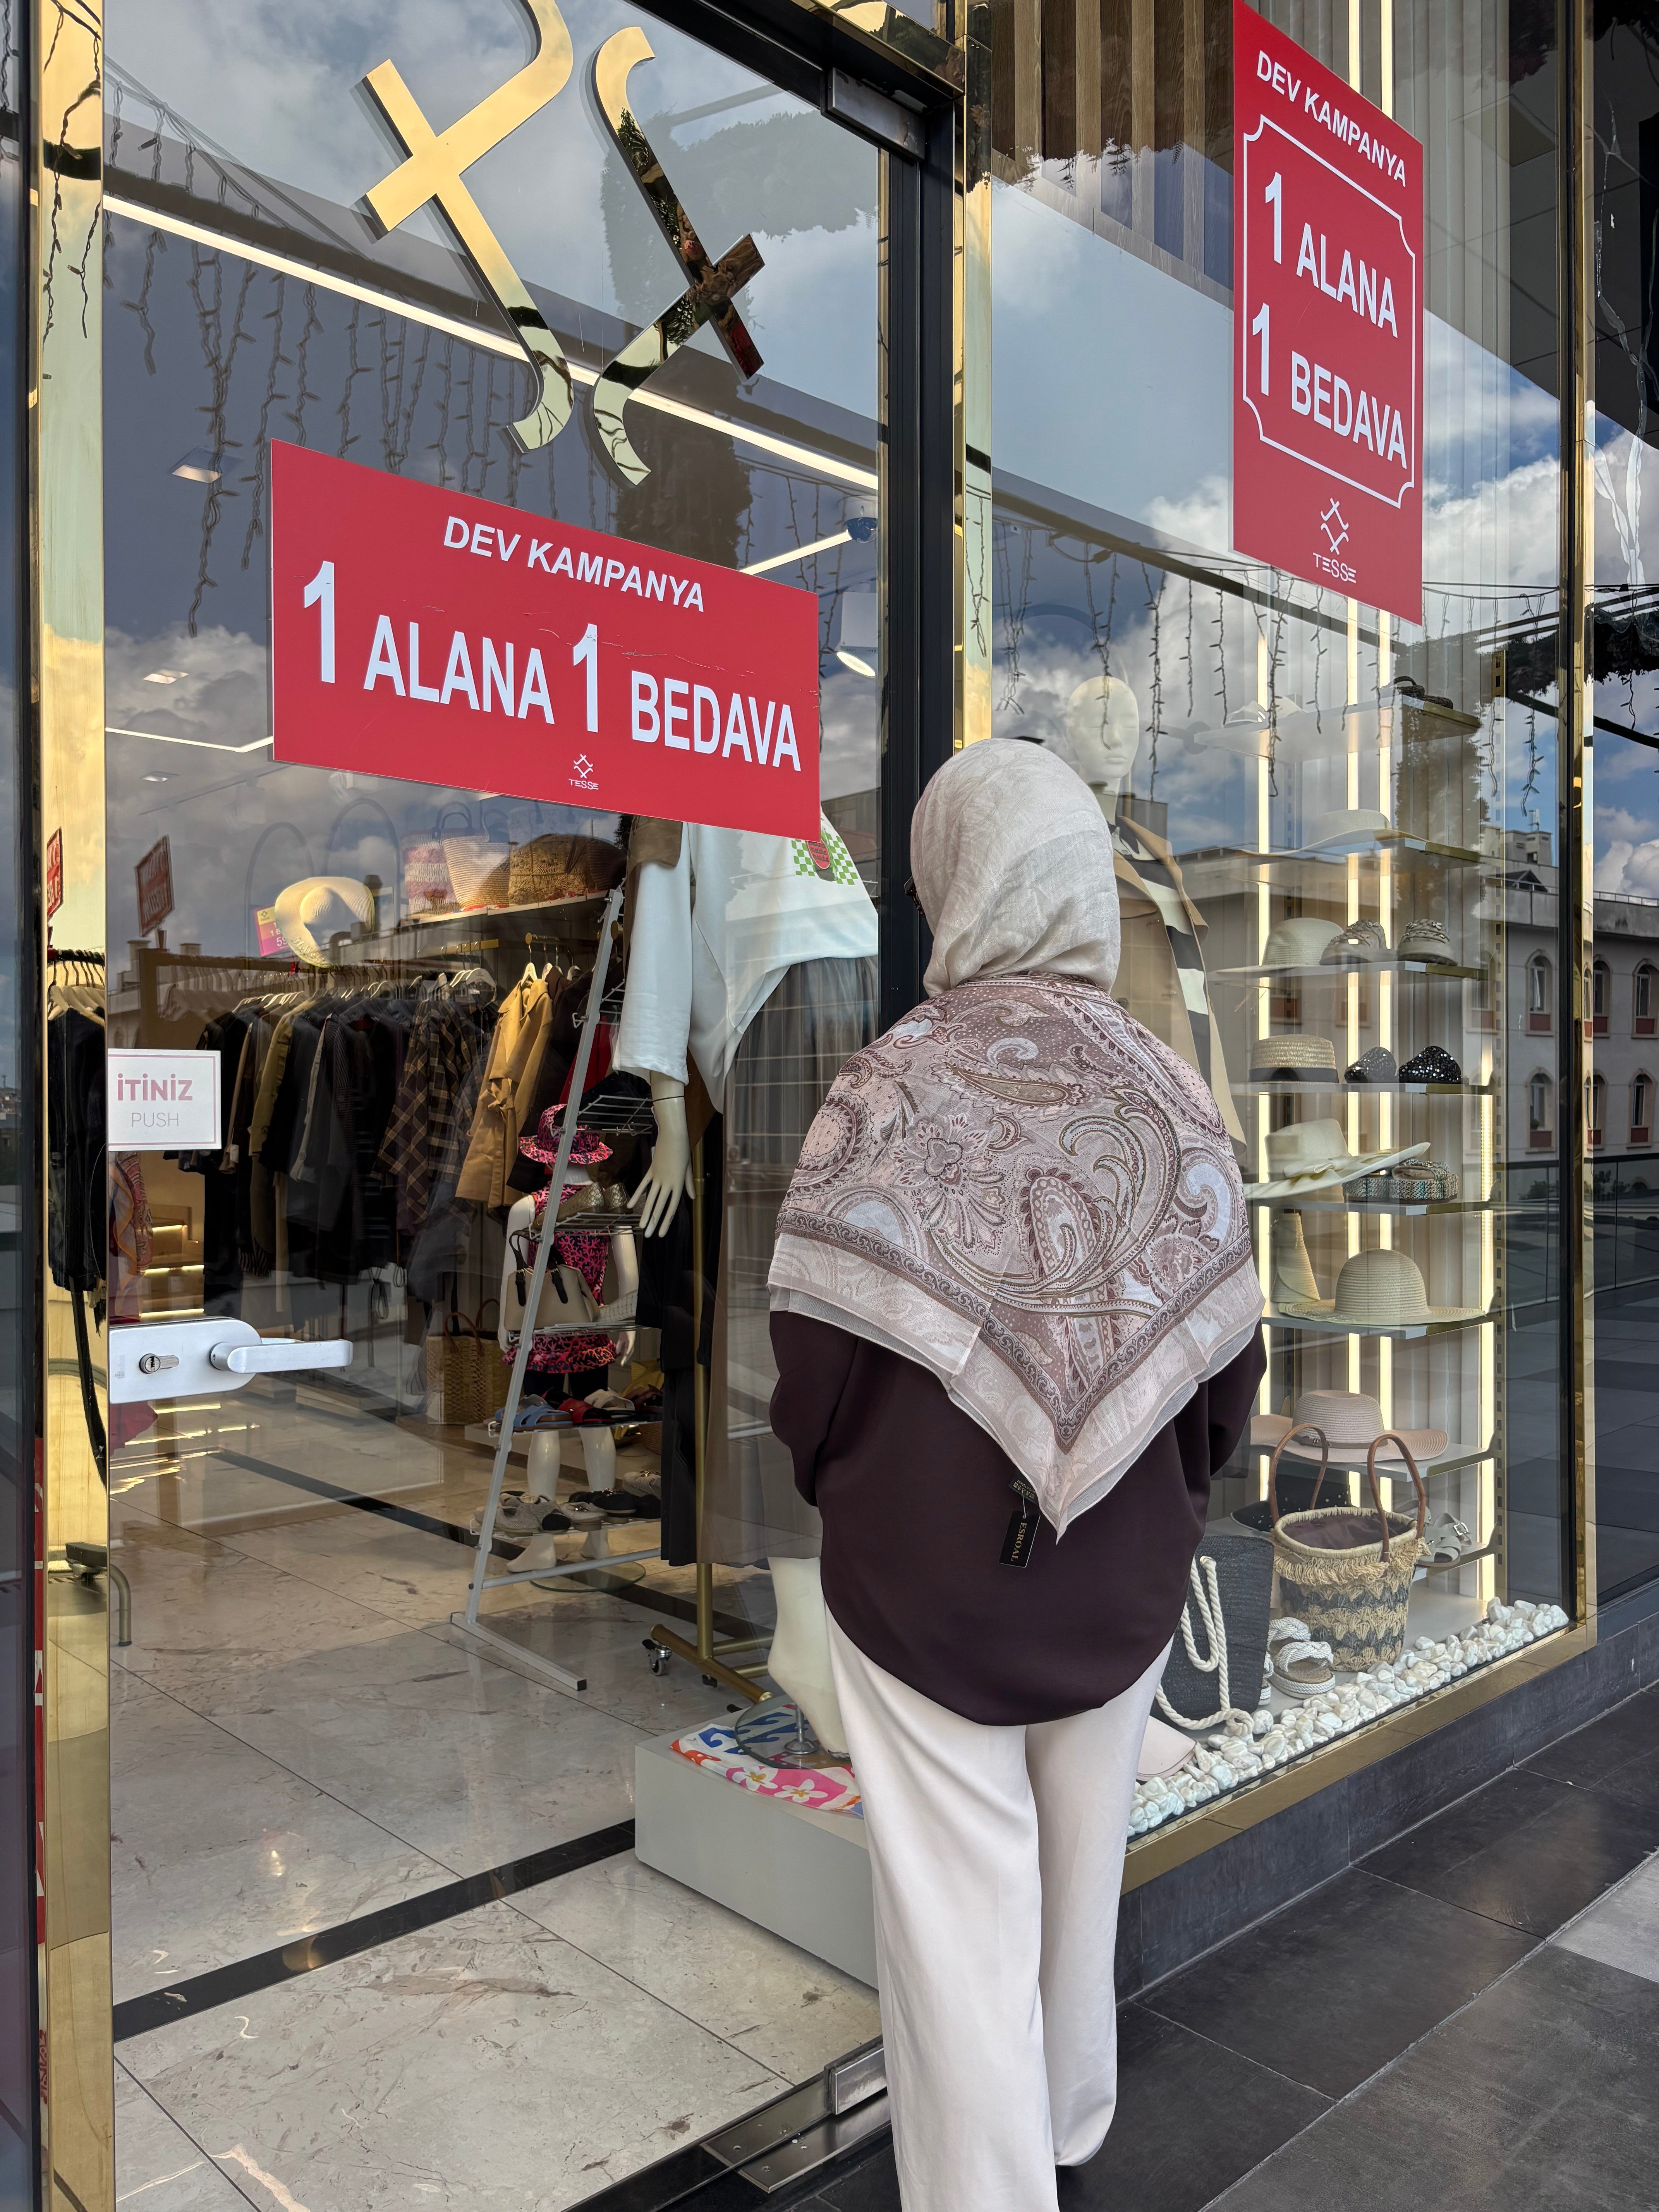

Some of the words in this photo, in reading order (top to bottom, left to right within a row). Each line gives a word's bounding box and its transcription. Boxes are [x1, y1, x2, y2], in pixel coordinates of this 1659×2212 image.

[1257, 50, 1301, 102] DEV
[1304, 87, 1406, 187] KAMPANYA
[1265, 172, 1282, 264] 1
[1296, 222, 1398, 338] ALANA
[1252, 302, 1269, 396] 1
[1291, 350, 1407, 469] BEDAVA
[443, 516, 521, 562] DEV
[527, 538, 704, 612] KAMPANYA
[1313, 552, 1357, 584] TESSE
[304, 560, 335, 684] 1
[363, 615, 555, 725] ALANA
[573, 623, 598, 733] 1
[632, 670, 801, 771] BEDAVA
[568, 779, 599, 790] TESSE
[118, 1073, 193, 1101] İTİNİZ
[132, 1112, 179, 1127] PUSH
[1011, 1522, 1027, 1561] ESROAL
